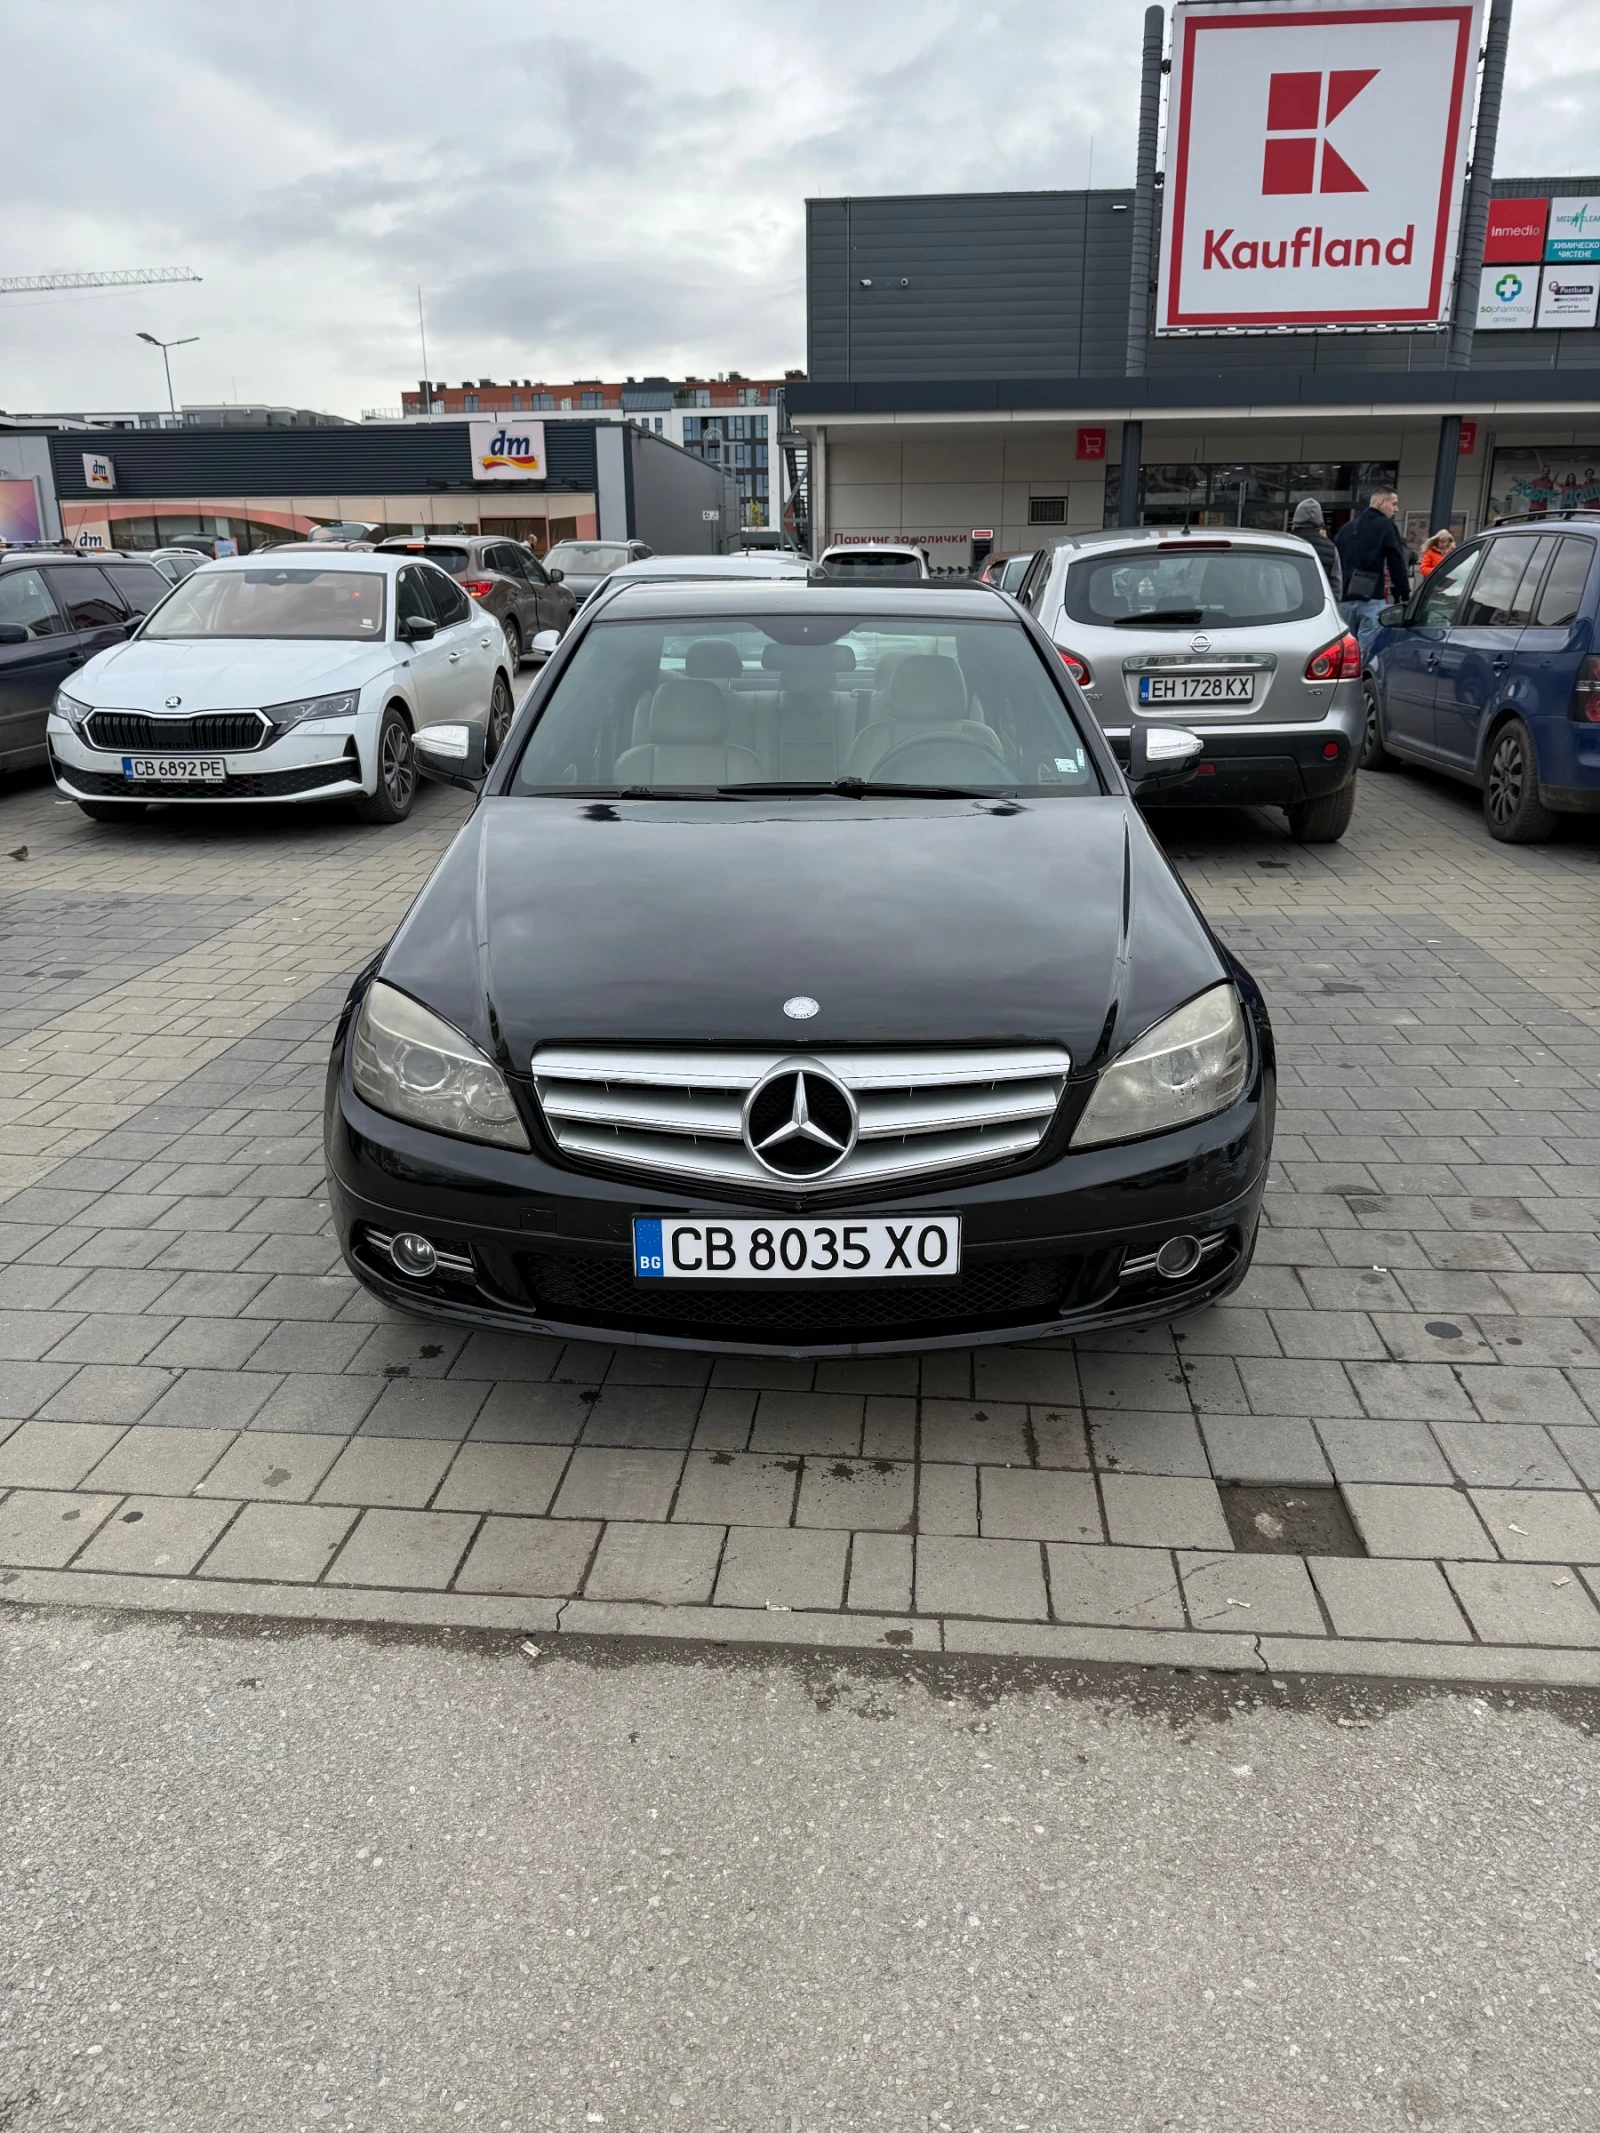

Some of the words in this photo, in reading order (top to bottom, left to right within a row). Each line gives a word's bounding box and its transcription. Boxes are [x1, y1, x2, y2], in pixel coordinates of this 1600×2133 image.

[1491, 225, 1540, 237] inmedio
[1203, 224, 1415, 270] Kaufland
[1552, 241, 1600, 250] ХИМИЧЕСКО
[1558, 250, 1592, 258] ЧИСТЕНЕ
[1559, 286, 1591, 294] Postbank
[1480, 305, 1532, 316] sopharmacy
[490, 429, 530, 456] dm
[93, 460, 106, 475] dm
[79, 532, 102, 547] dm
[894, 535, 909, 544] за
[911, 534, 967, 544] олички
[1152, 680, 1175, 698] EH
[1182, 679, 1222, 697] 1728
[1226, 678, 1250, 696] KX
[134, 761, 155, 776] CB
[159, 761, 198, 777] 6892
[200, 761, 222, 777] PE
[671, 1226, 736, 1271] CB
[749, 1226, 871, 1271] 8035
[884, 1225, 948, 1268] XO
[640, 1256, 661, 1269] BG
